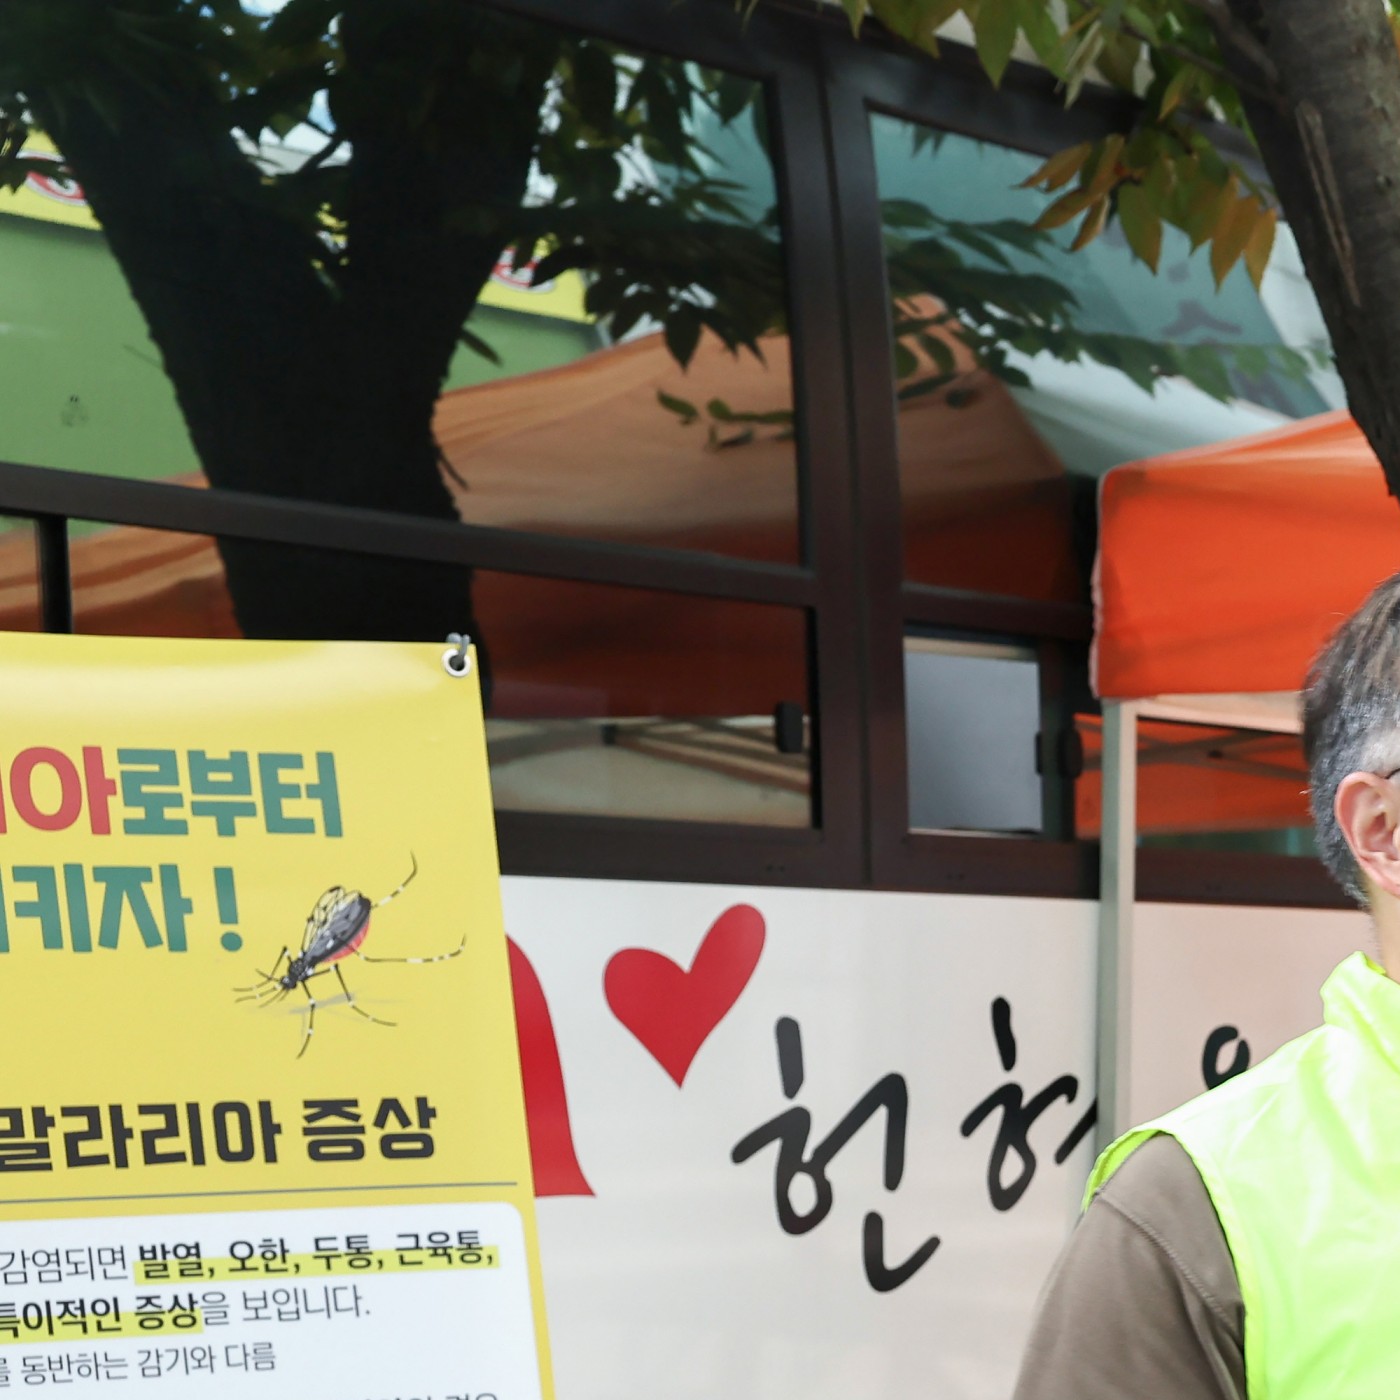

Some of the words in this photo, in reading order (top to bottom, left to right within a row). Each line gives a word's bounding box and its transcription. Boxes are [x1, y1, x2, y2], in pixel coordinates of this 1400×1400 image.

[0, 746, 343, 837] 아로부터
[0, 863, 193, 953] 키자
[0, 1100, 281, 1172] 말라리아
[302, 1096, 437, 1162] 증상
[0, 1245, 128, 1285] 감염되면
[139, 1241, 216, 1280] 발열,
[228, 1238, 301, 1274] 오한,
[313, 1234, 384, 1271] 두통,
[395, 1230, 493, 1266] 근육통,
[134, 1289, 230, 1331] 증상을
[242, 1284, 371, 1322] 보입니다.
[21, 1351, 128, 1386] 동반하는
[137, 1345, 217, 1378] 감기와
[224, 1340, 276, 1372] 다름
